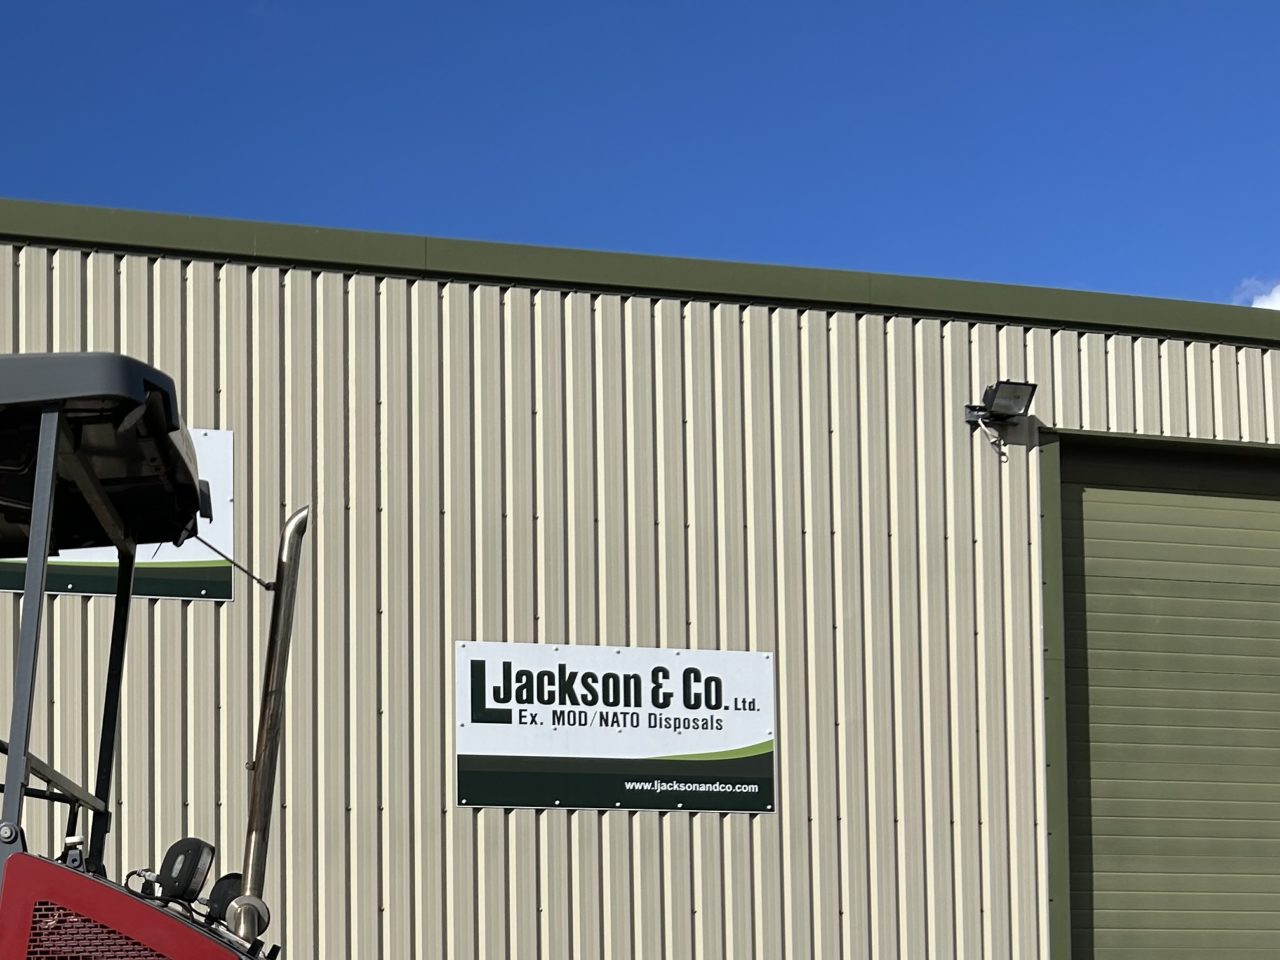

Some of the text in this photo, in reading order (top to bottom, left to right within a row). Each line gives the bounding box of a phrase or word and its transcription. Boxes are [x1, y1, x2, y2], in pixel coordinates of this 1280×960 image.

[650, 666, 674, 709] &
[682, 666, 730, 711] Co.
[733, 698, 761, 712] Ltd.
[518, 709, 724, 733] Ex. MOD/NATO Disposals
[624, 779, 759, 794] www.ljacksonandco.com
